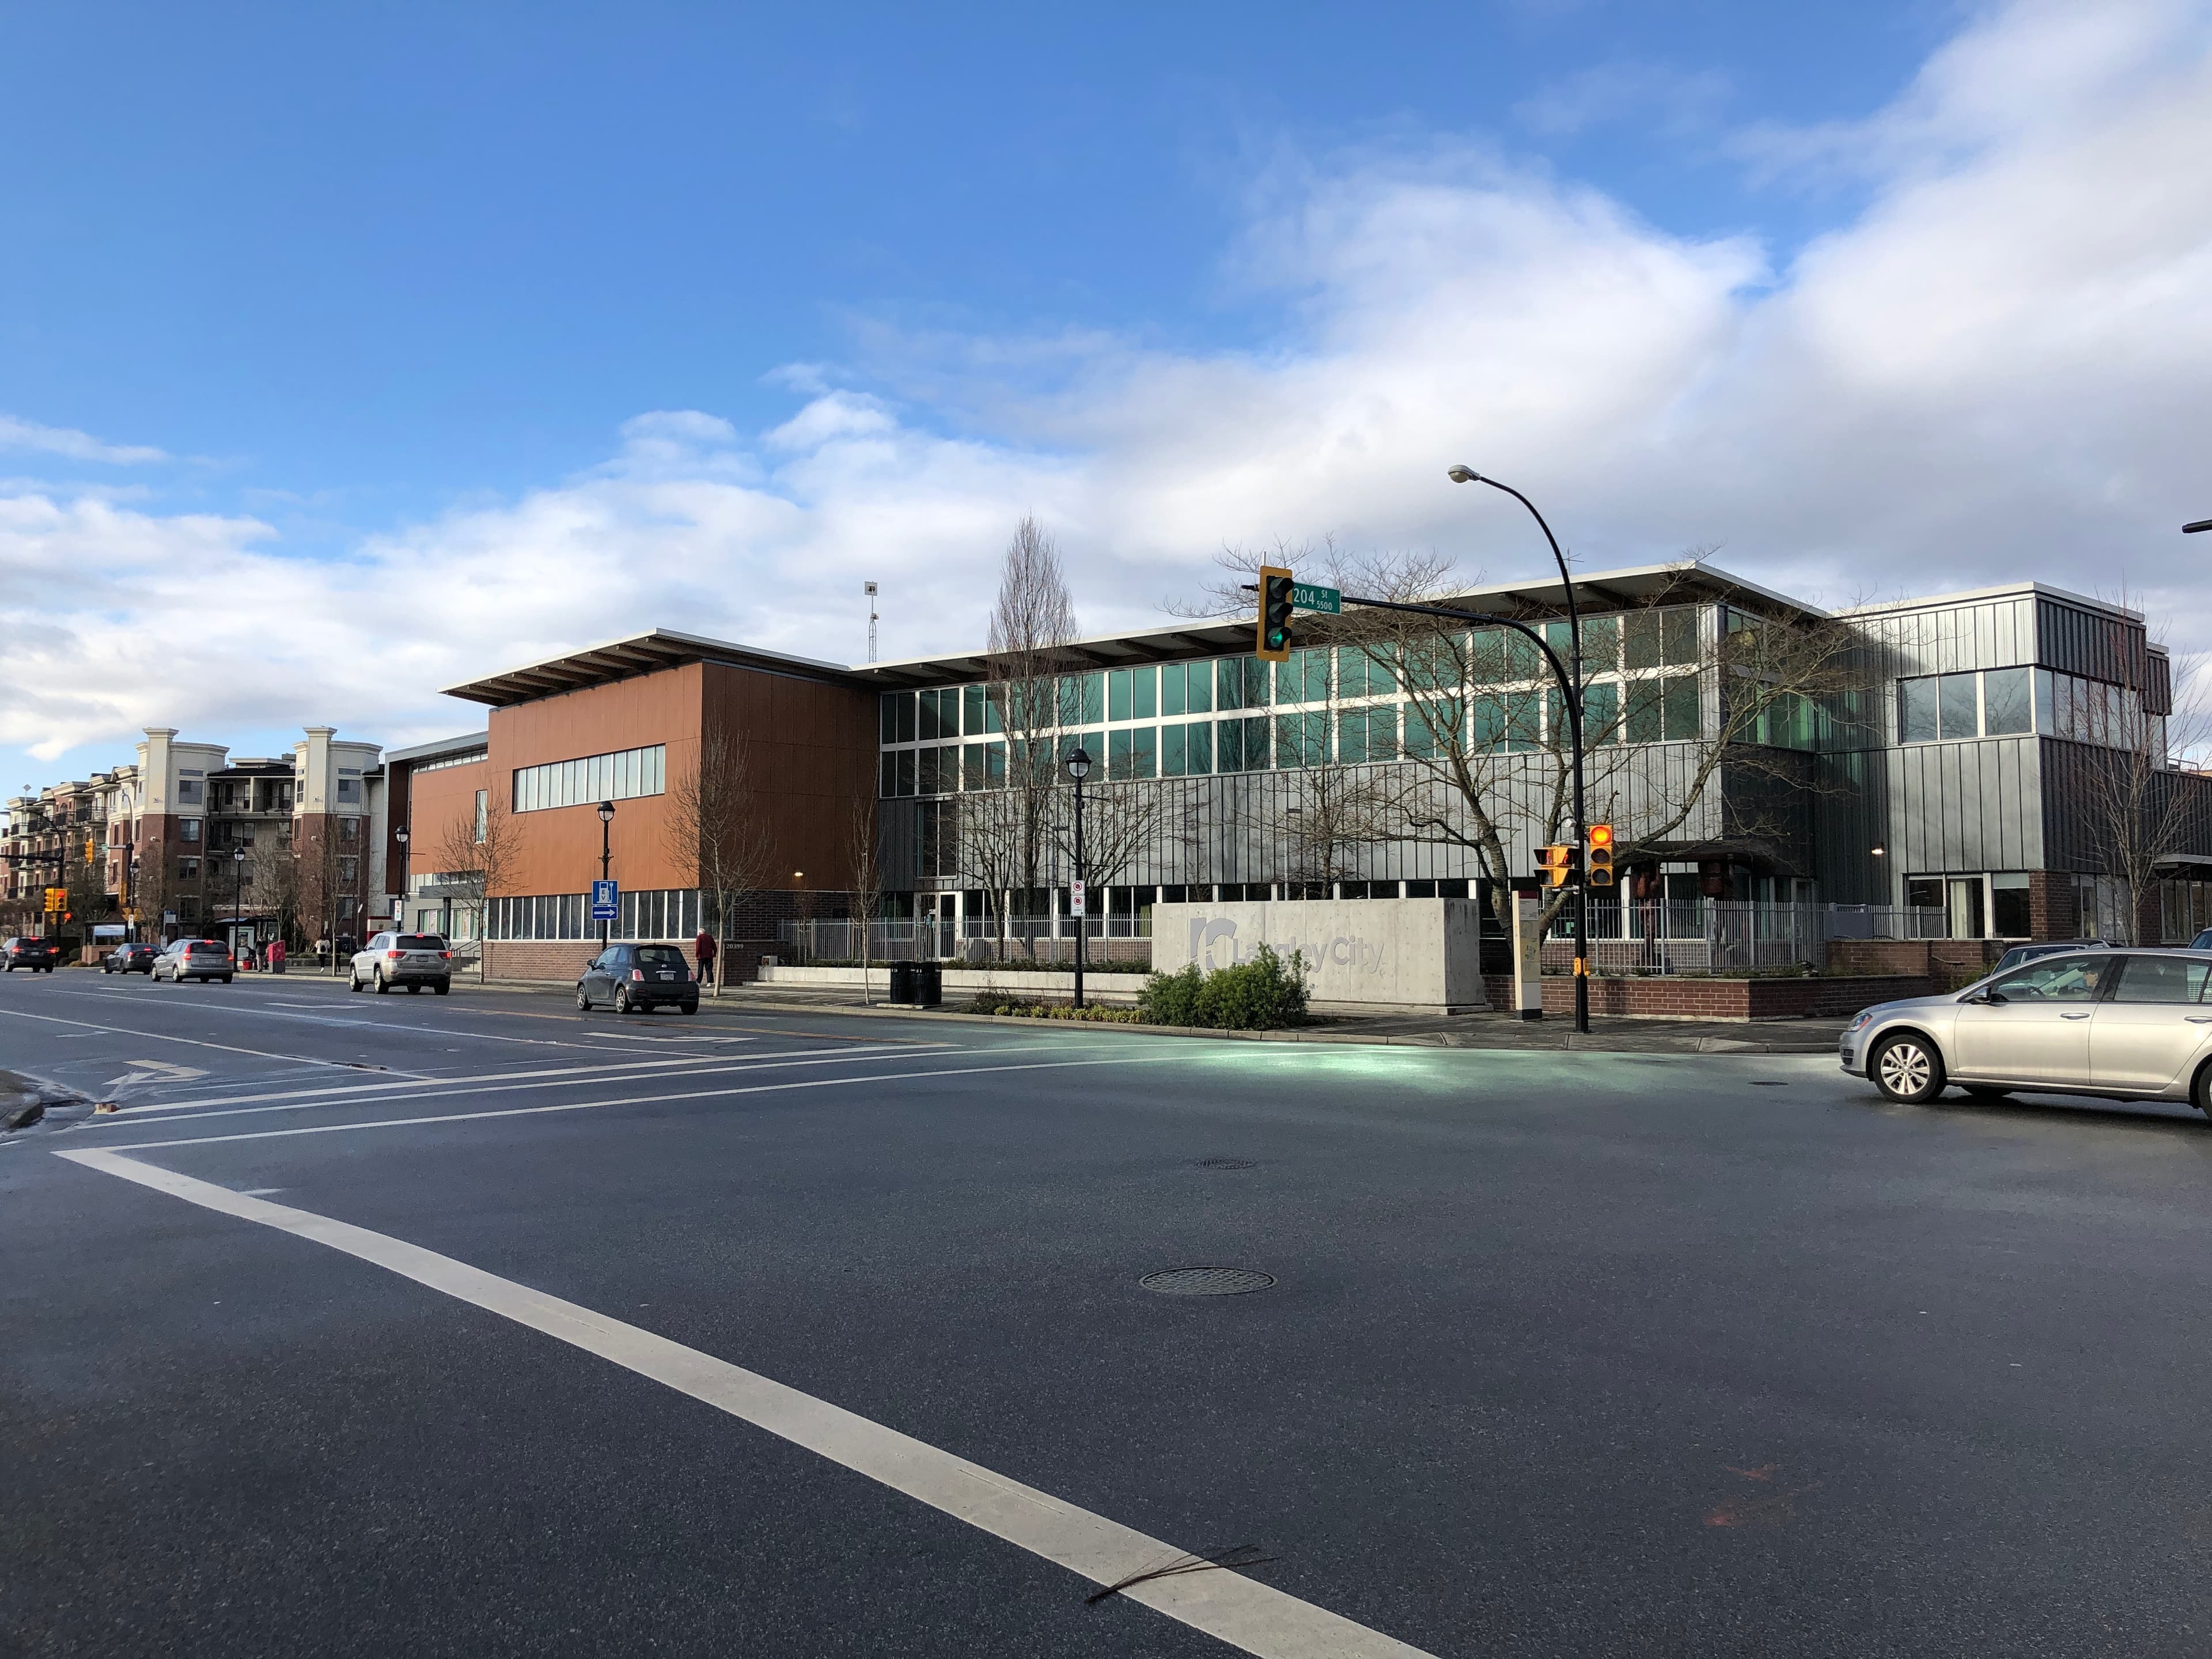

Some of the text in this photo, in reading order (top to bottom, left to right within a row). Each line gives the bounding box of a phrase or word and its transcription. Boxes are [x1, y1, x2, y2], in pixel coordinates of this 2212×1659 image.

[1294, 588, 1328, 605] 204 St
[1316, 600, 1332, 611] 5500
[1233, 935, 1384, 974] Lagley City
